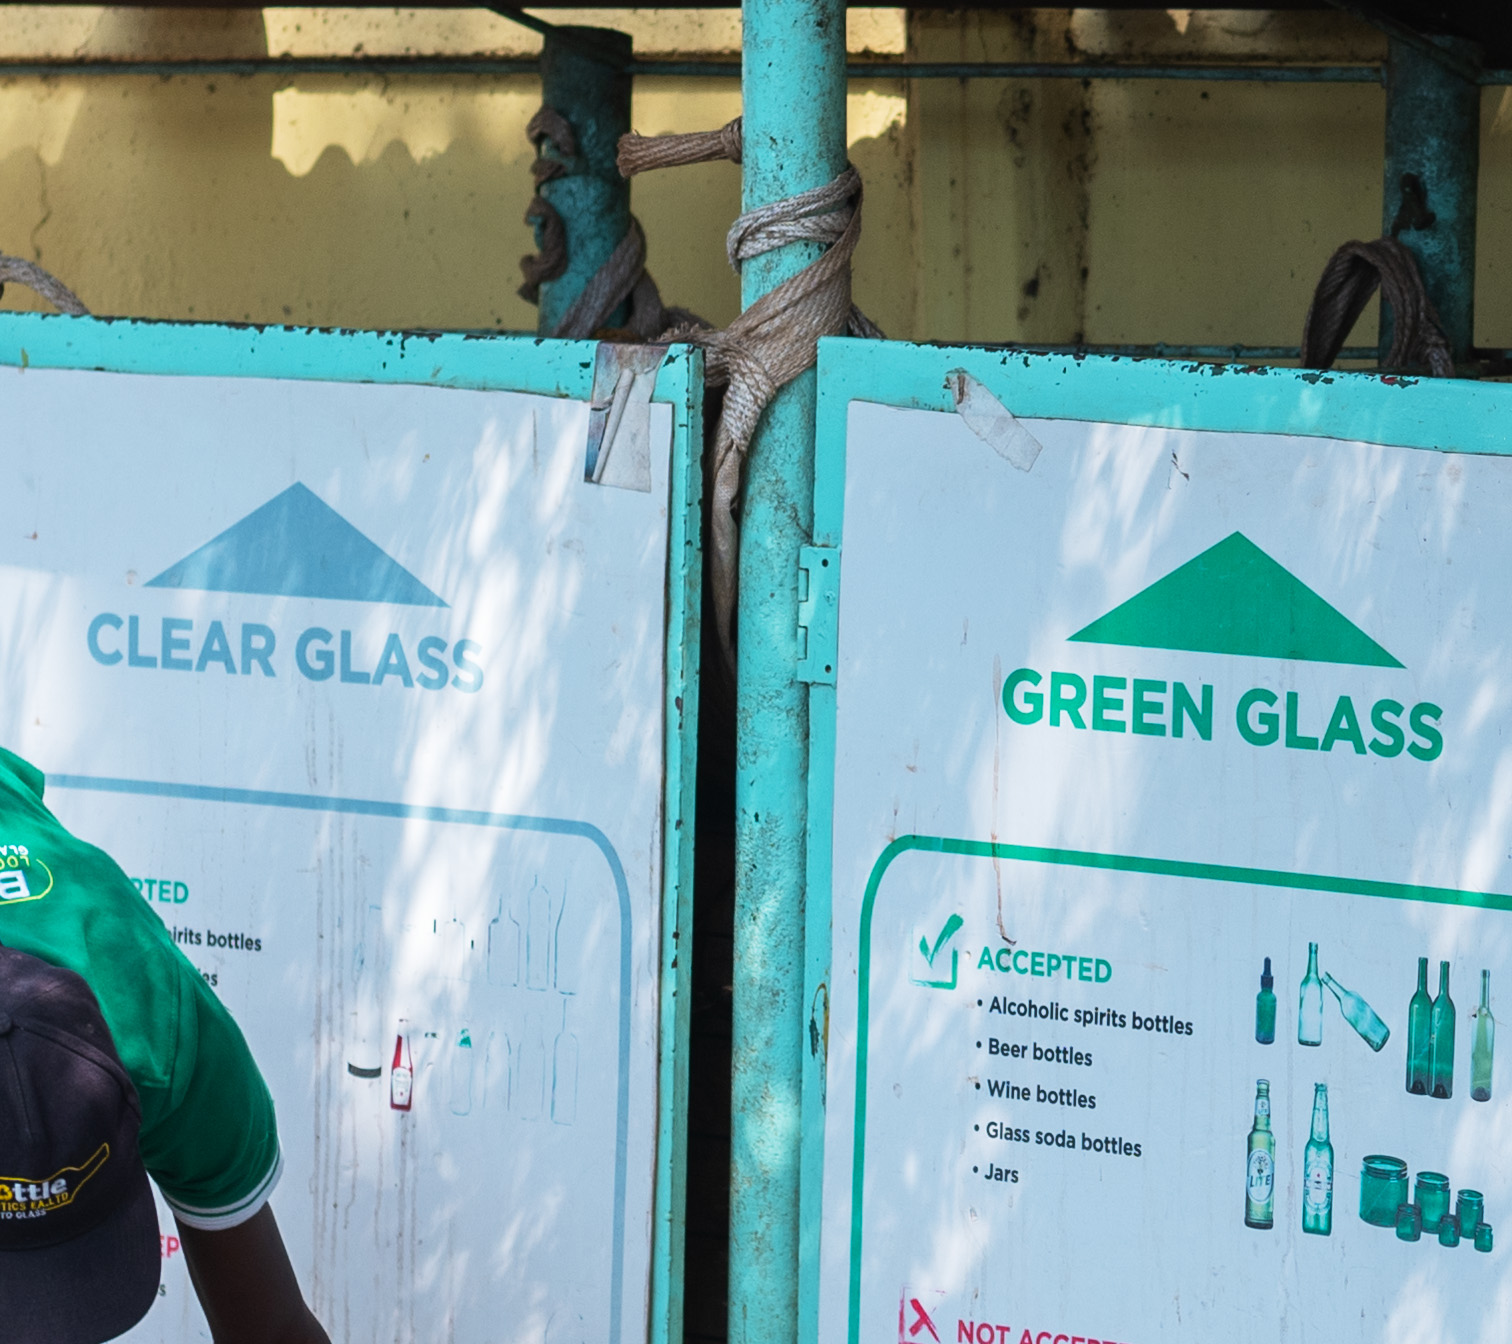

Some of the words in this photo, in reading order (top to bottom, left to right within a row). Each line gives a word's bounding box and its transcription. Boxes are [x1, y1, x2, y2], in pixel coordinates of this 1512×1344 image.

[87, 612, 275, 677] CLEAR
[295, 627, 483, 690] GLASS
[1002, 668, 1213, 741] GREEN
[1236, 688, 1443, 761] GLASS
[207, 930, 261, 951] bottles
[977, 947, 1112, 983] ACCEPTED
[989, 996, 1068, 1021] Alcoholic
[1073, 1006, 1126, 1028] spirits
[1132, 1011, 1192, 1035] bottles
[987, 1079, 1030, 1101] Wine
[1036, 1084, 1096, 1109] bottles
[986, 1121, 1030, 1142] Glass
[1035, 1129, 1075, 1148] soda
[1081, 1132, 1141, 1157] bottles
[984, 1163, 1018, 1183] Jars
